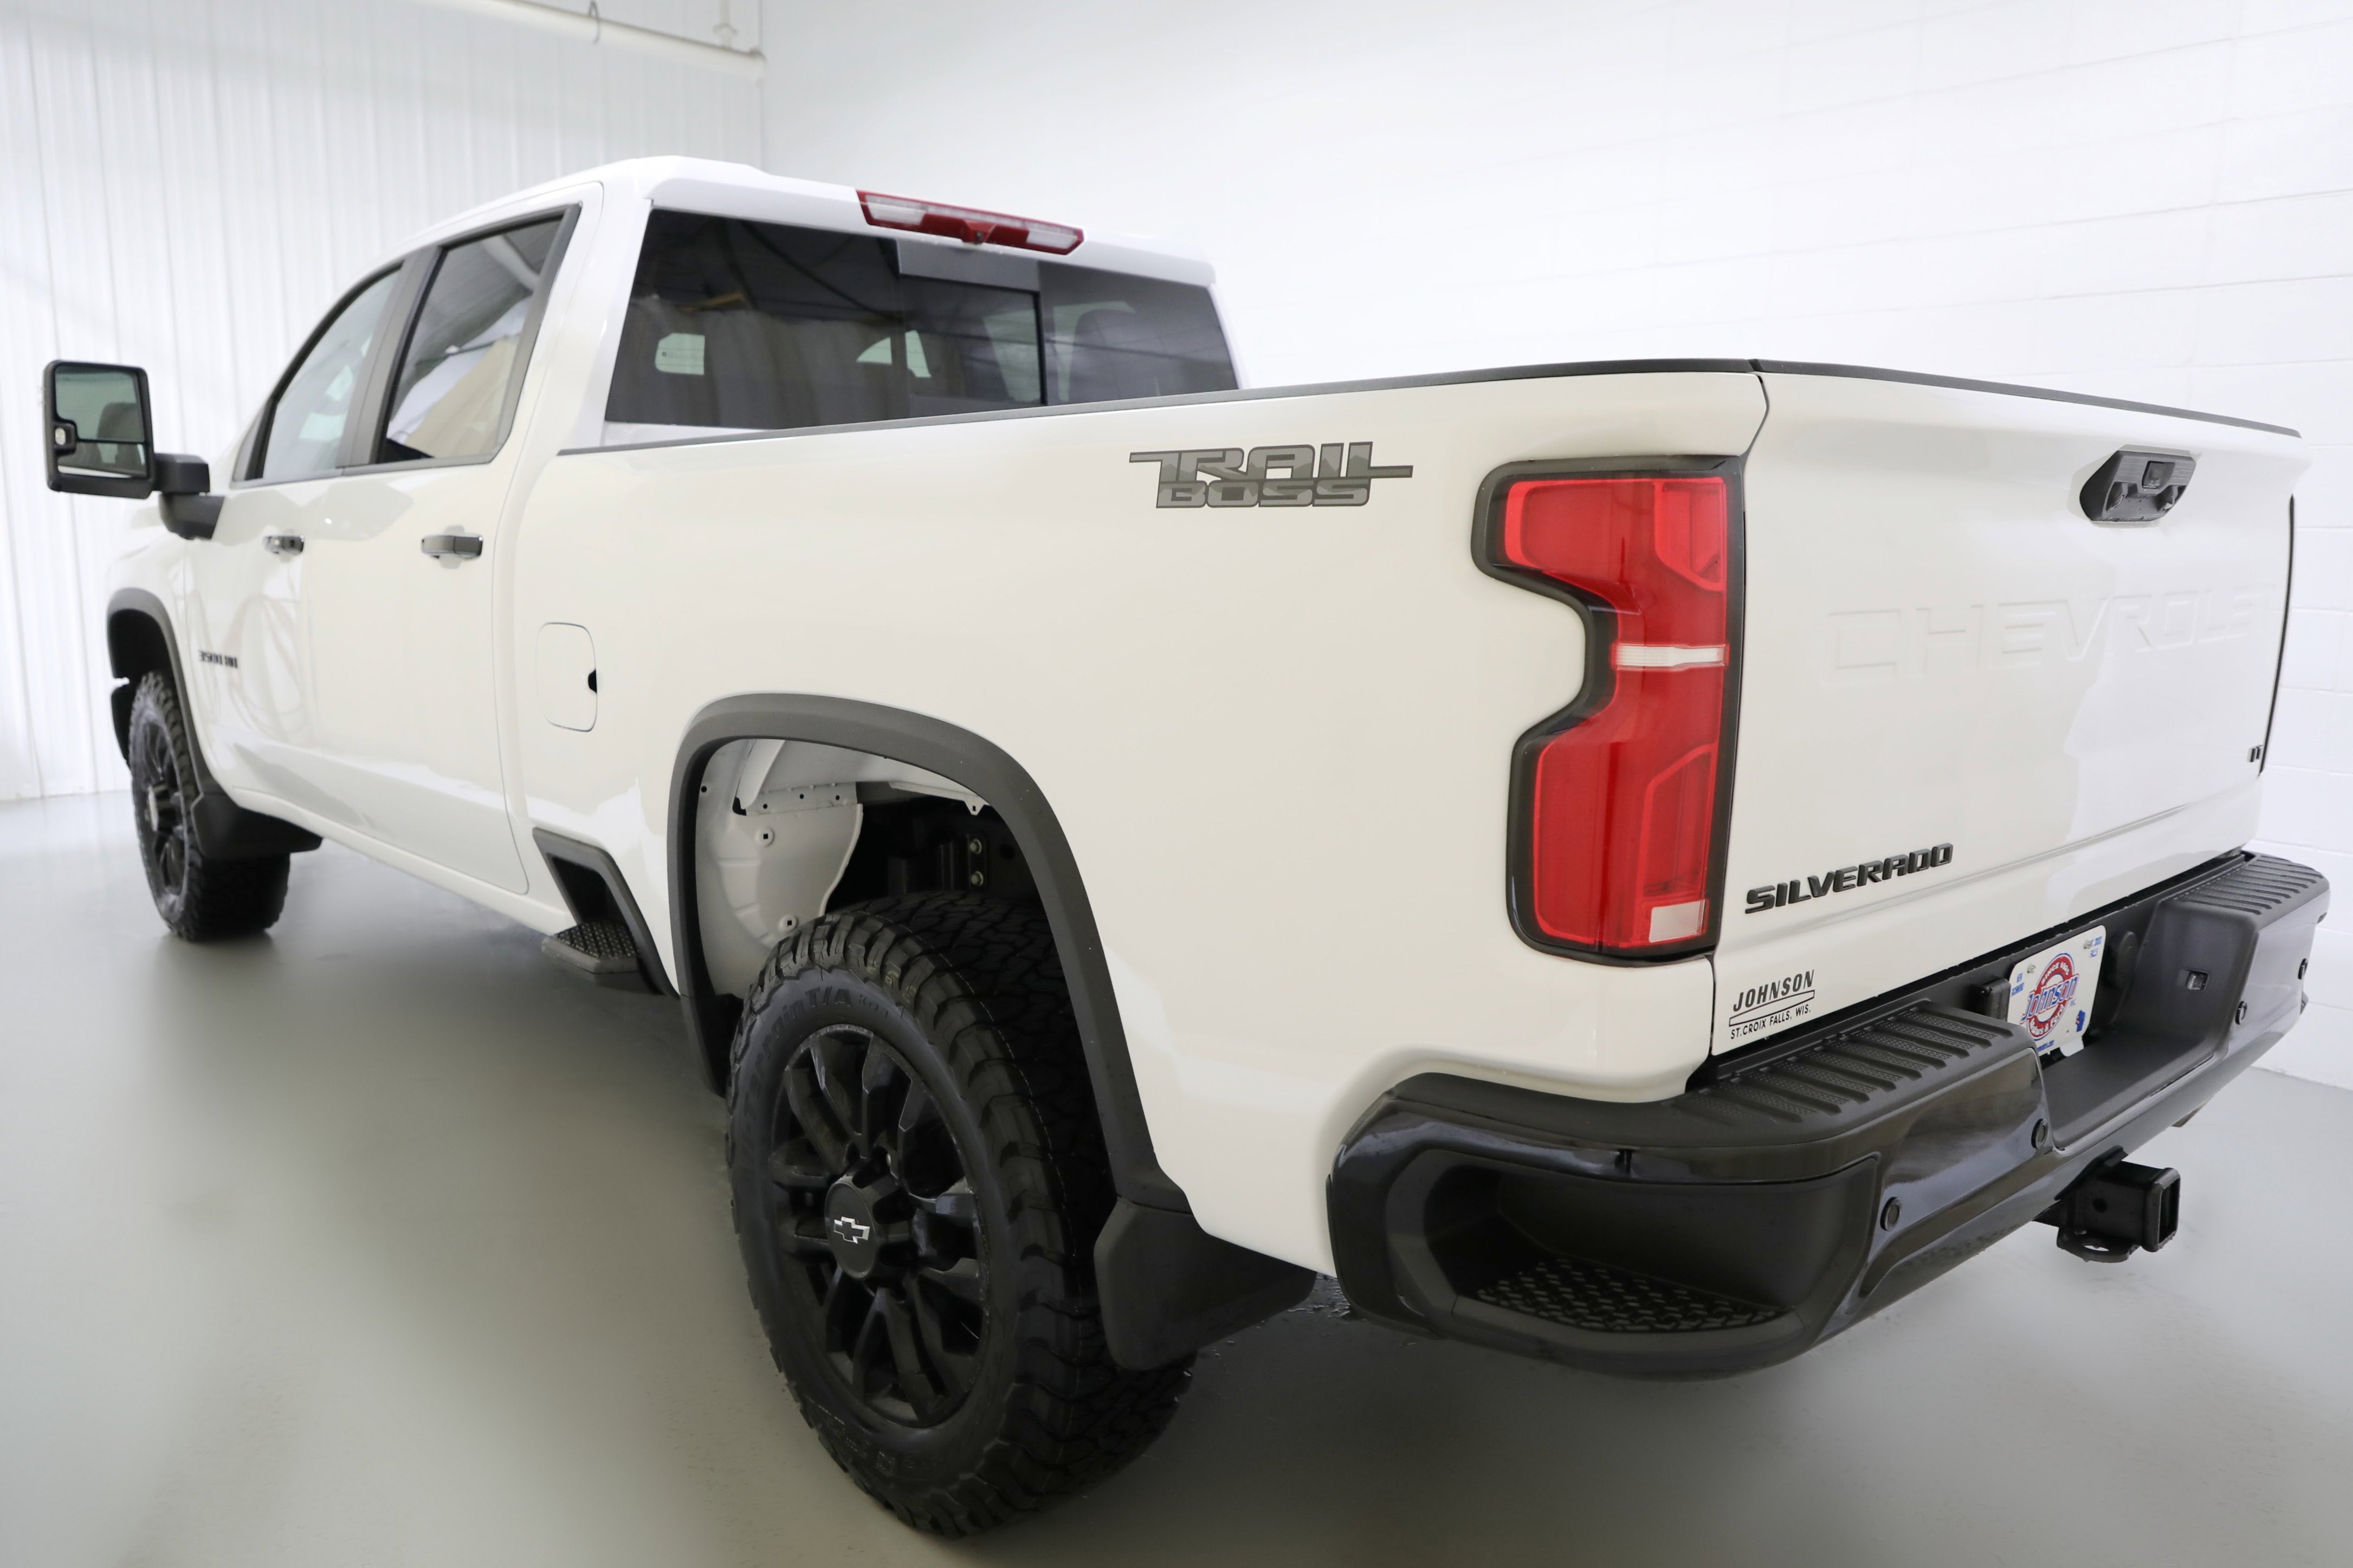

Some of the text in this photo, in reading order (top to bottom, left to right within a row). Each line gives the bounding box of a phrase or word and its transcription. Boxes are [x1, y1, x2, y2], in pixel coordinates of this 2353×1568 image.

[1129, 441, 1414, 482] TRAIL
[1156, 478, 1372, 508] BOSS
[1745, 842, 1954, 914] SILVERADO
[805, 985, 852, 1008] T/A
[1733, 969, 1814, 1012] JOHNSON
[2021, 974, 2079, 1025] Johnson
[1769, 1010, 1792, 1026] FALLS,
[1795, 1003, 1811, 1017] WIS.
